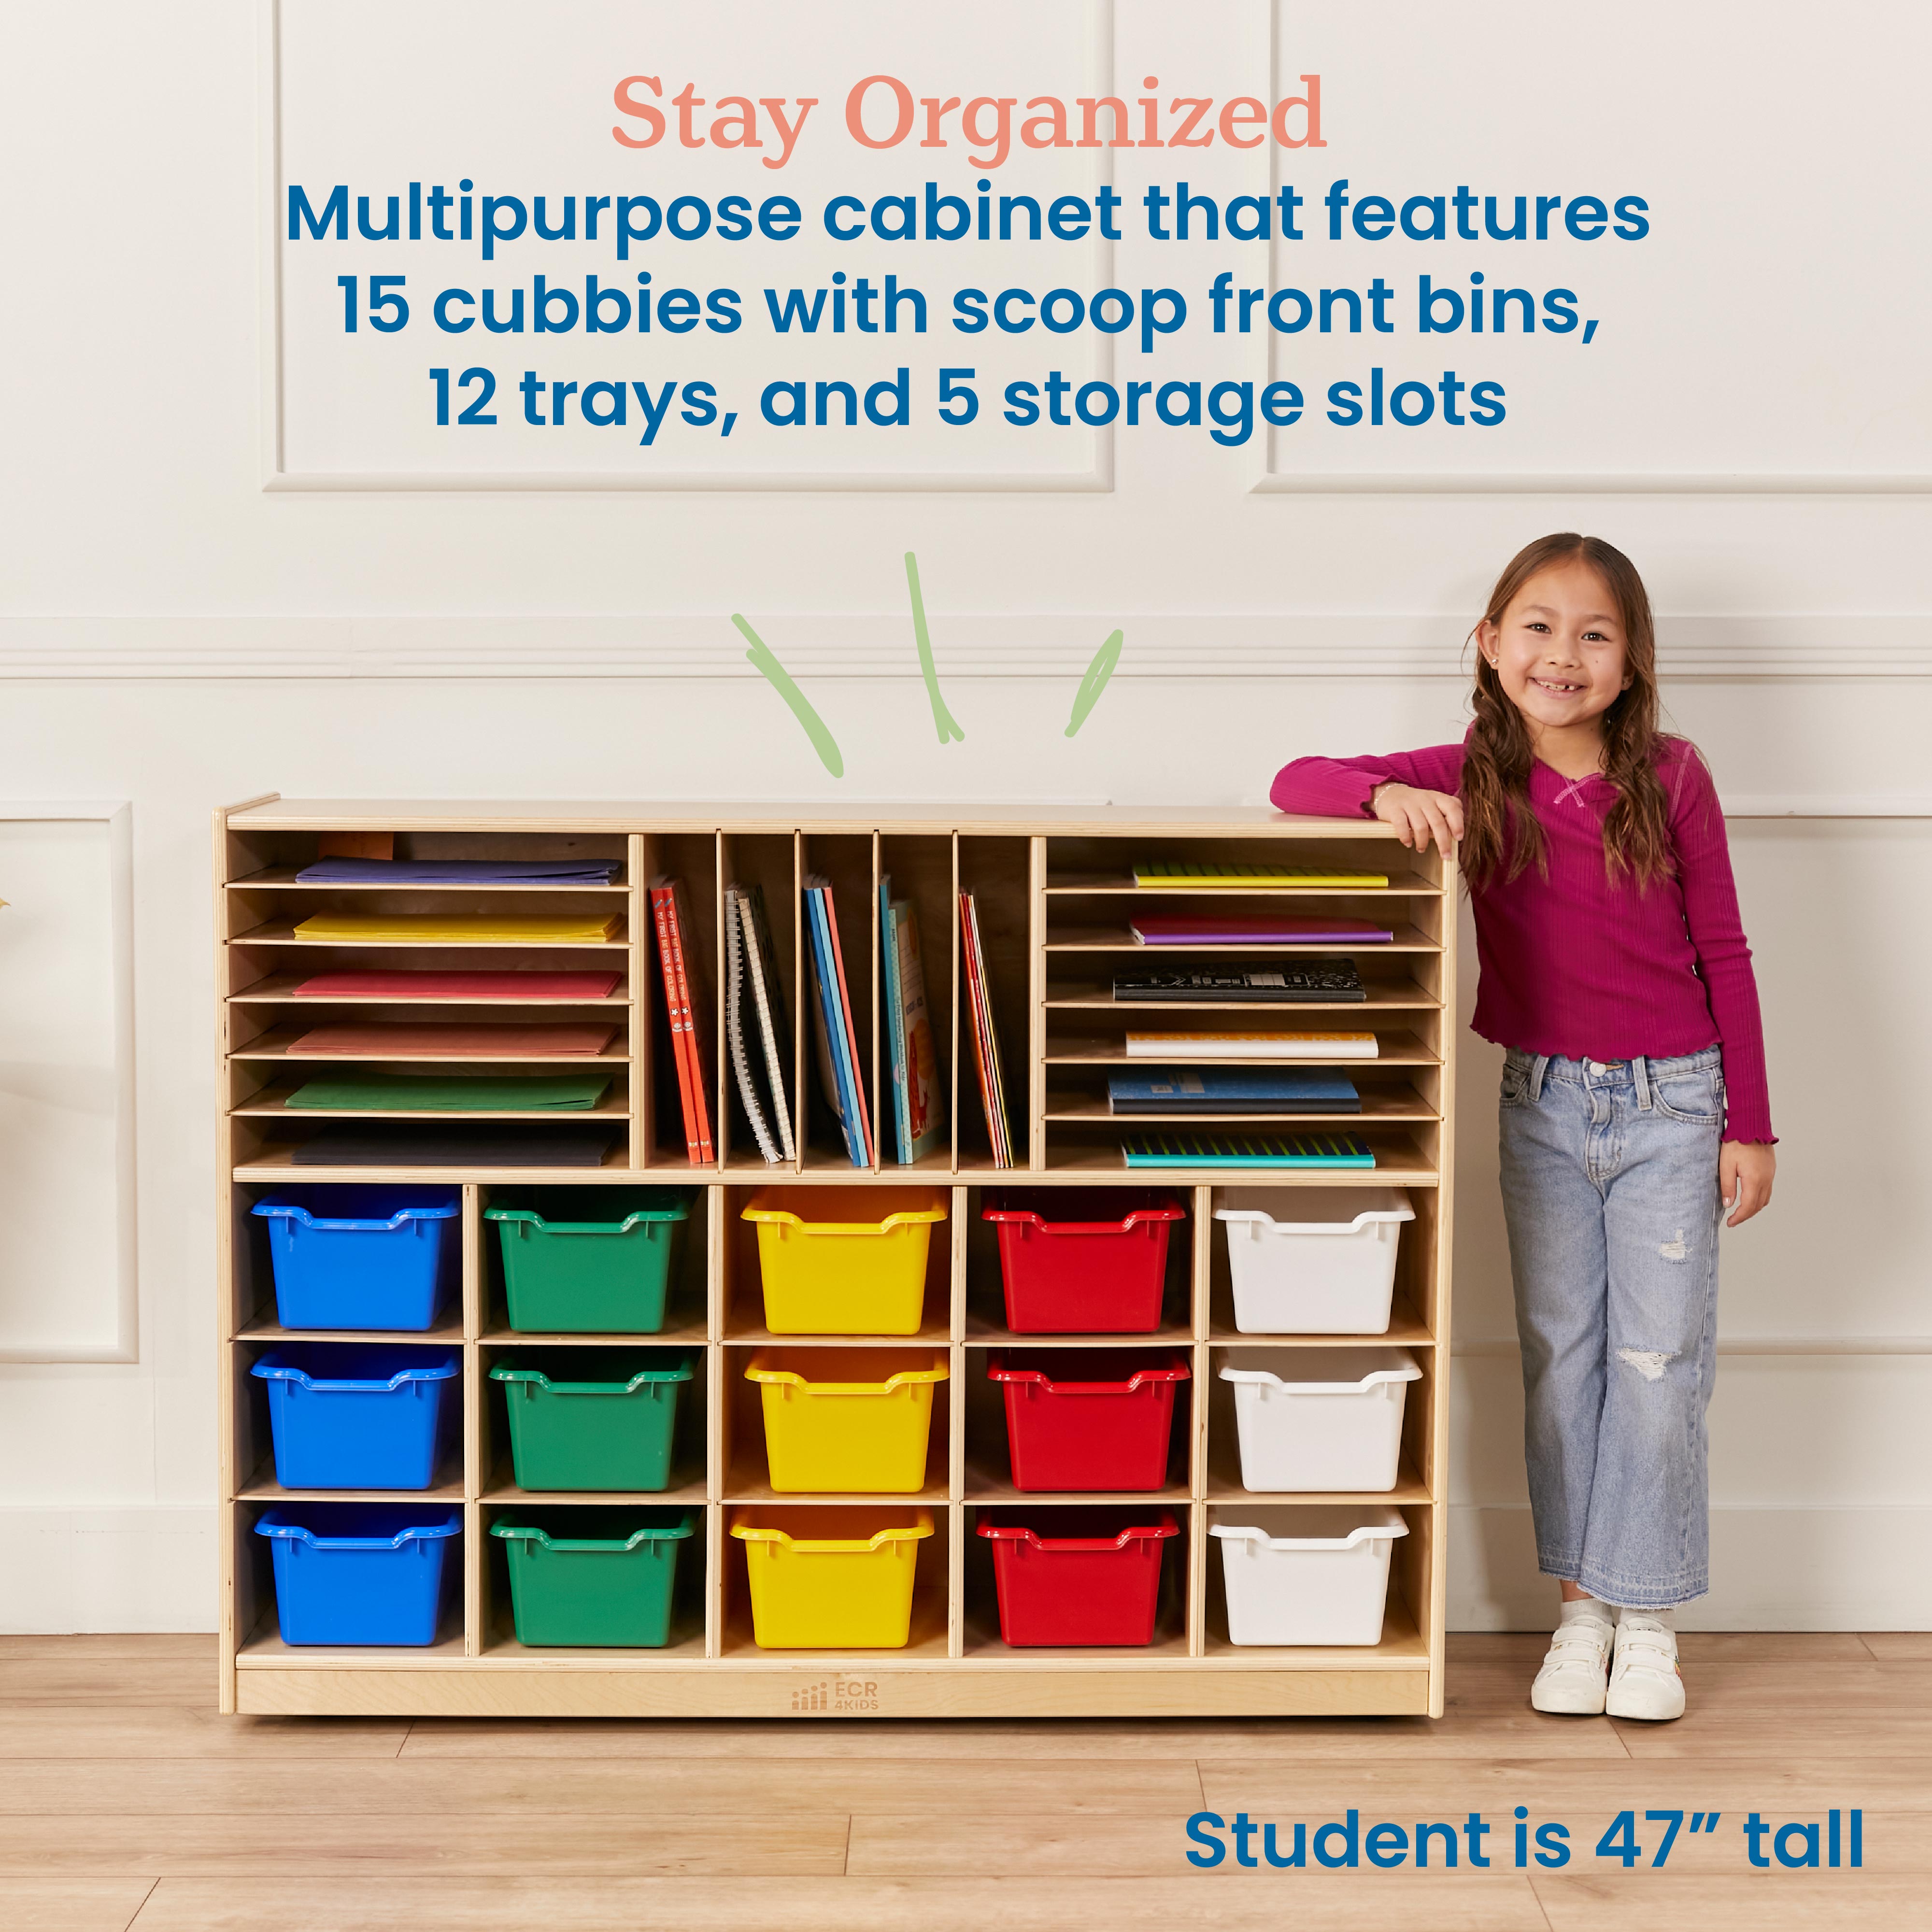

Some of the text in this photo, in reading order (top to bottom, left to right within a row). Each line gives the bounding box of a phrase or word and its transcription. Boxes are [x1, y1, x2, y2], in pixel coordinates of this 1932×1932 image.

[657, 912, 664, 920] MY
[667, 975, 676, 1002] COLORING
[677, 974, 686, 1000] COLORING
[836, 1682, 878, 1697] ECR
[835, 1700, 879, 1710] 4KIDS
